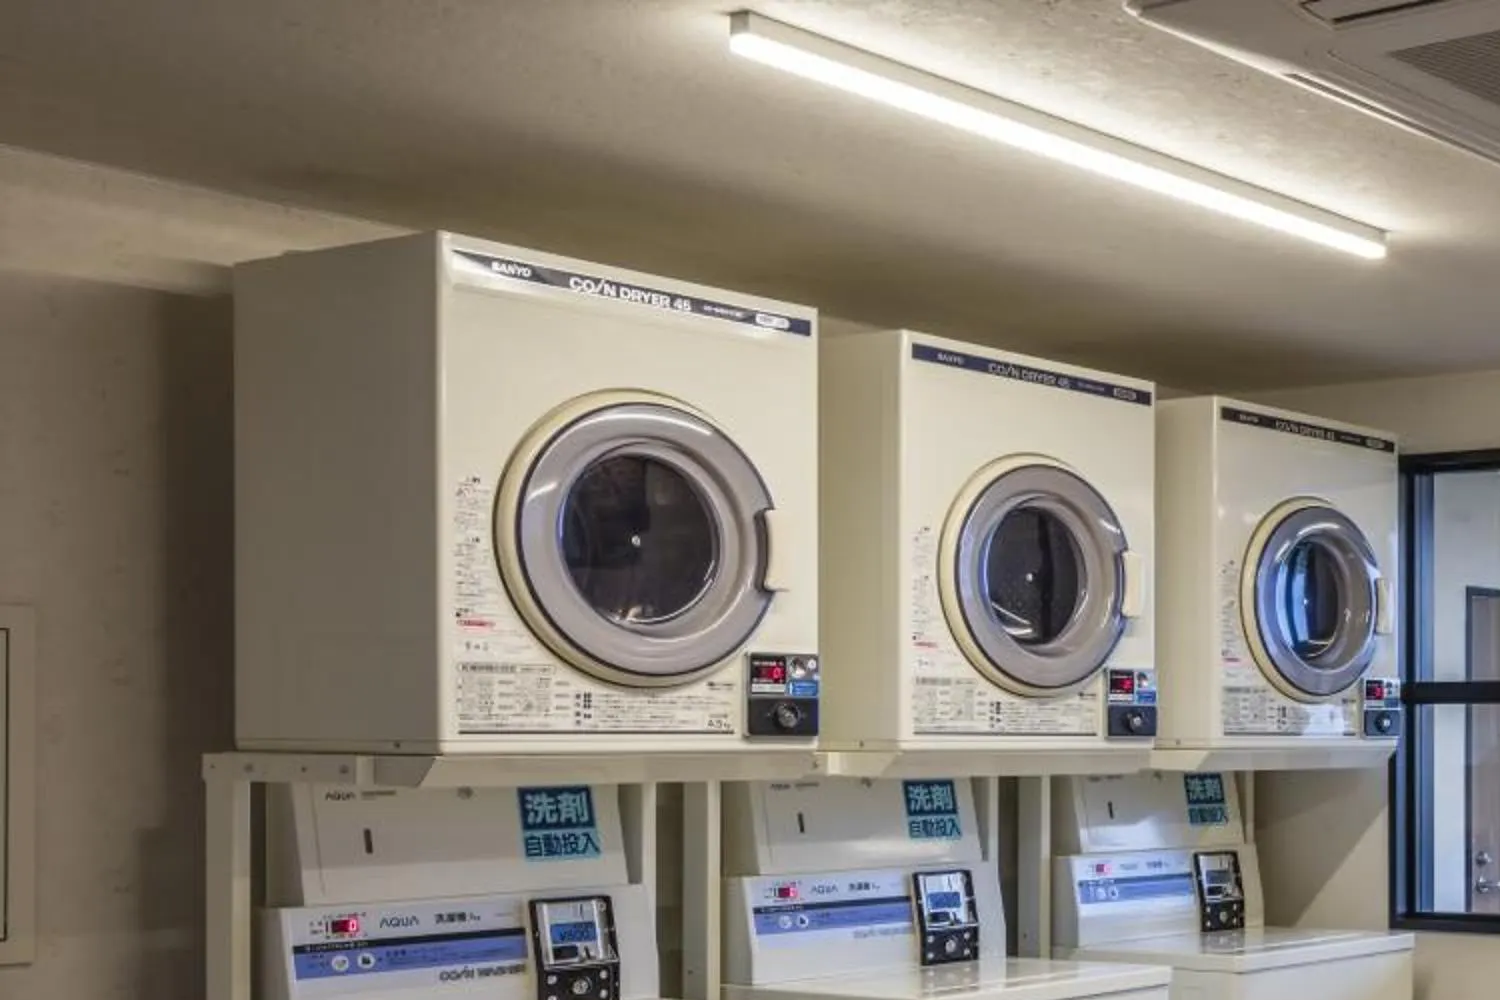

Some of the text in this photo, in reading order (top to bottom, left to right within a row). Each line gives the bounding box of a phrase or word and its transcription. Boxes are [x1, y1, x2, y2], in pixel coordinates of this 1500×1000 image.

[491, 261, 532, 278] SANYO
[619, 286, 671, 308] DRYER
[673, 297, 692, 312] 45
[524, 792, 588, 825] 洗剤
[907, 784, 954, 811] 洗剤
[525, 832, 601, 857] 自動投入
[380, 914, 420, 929] AQUA
